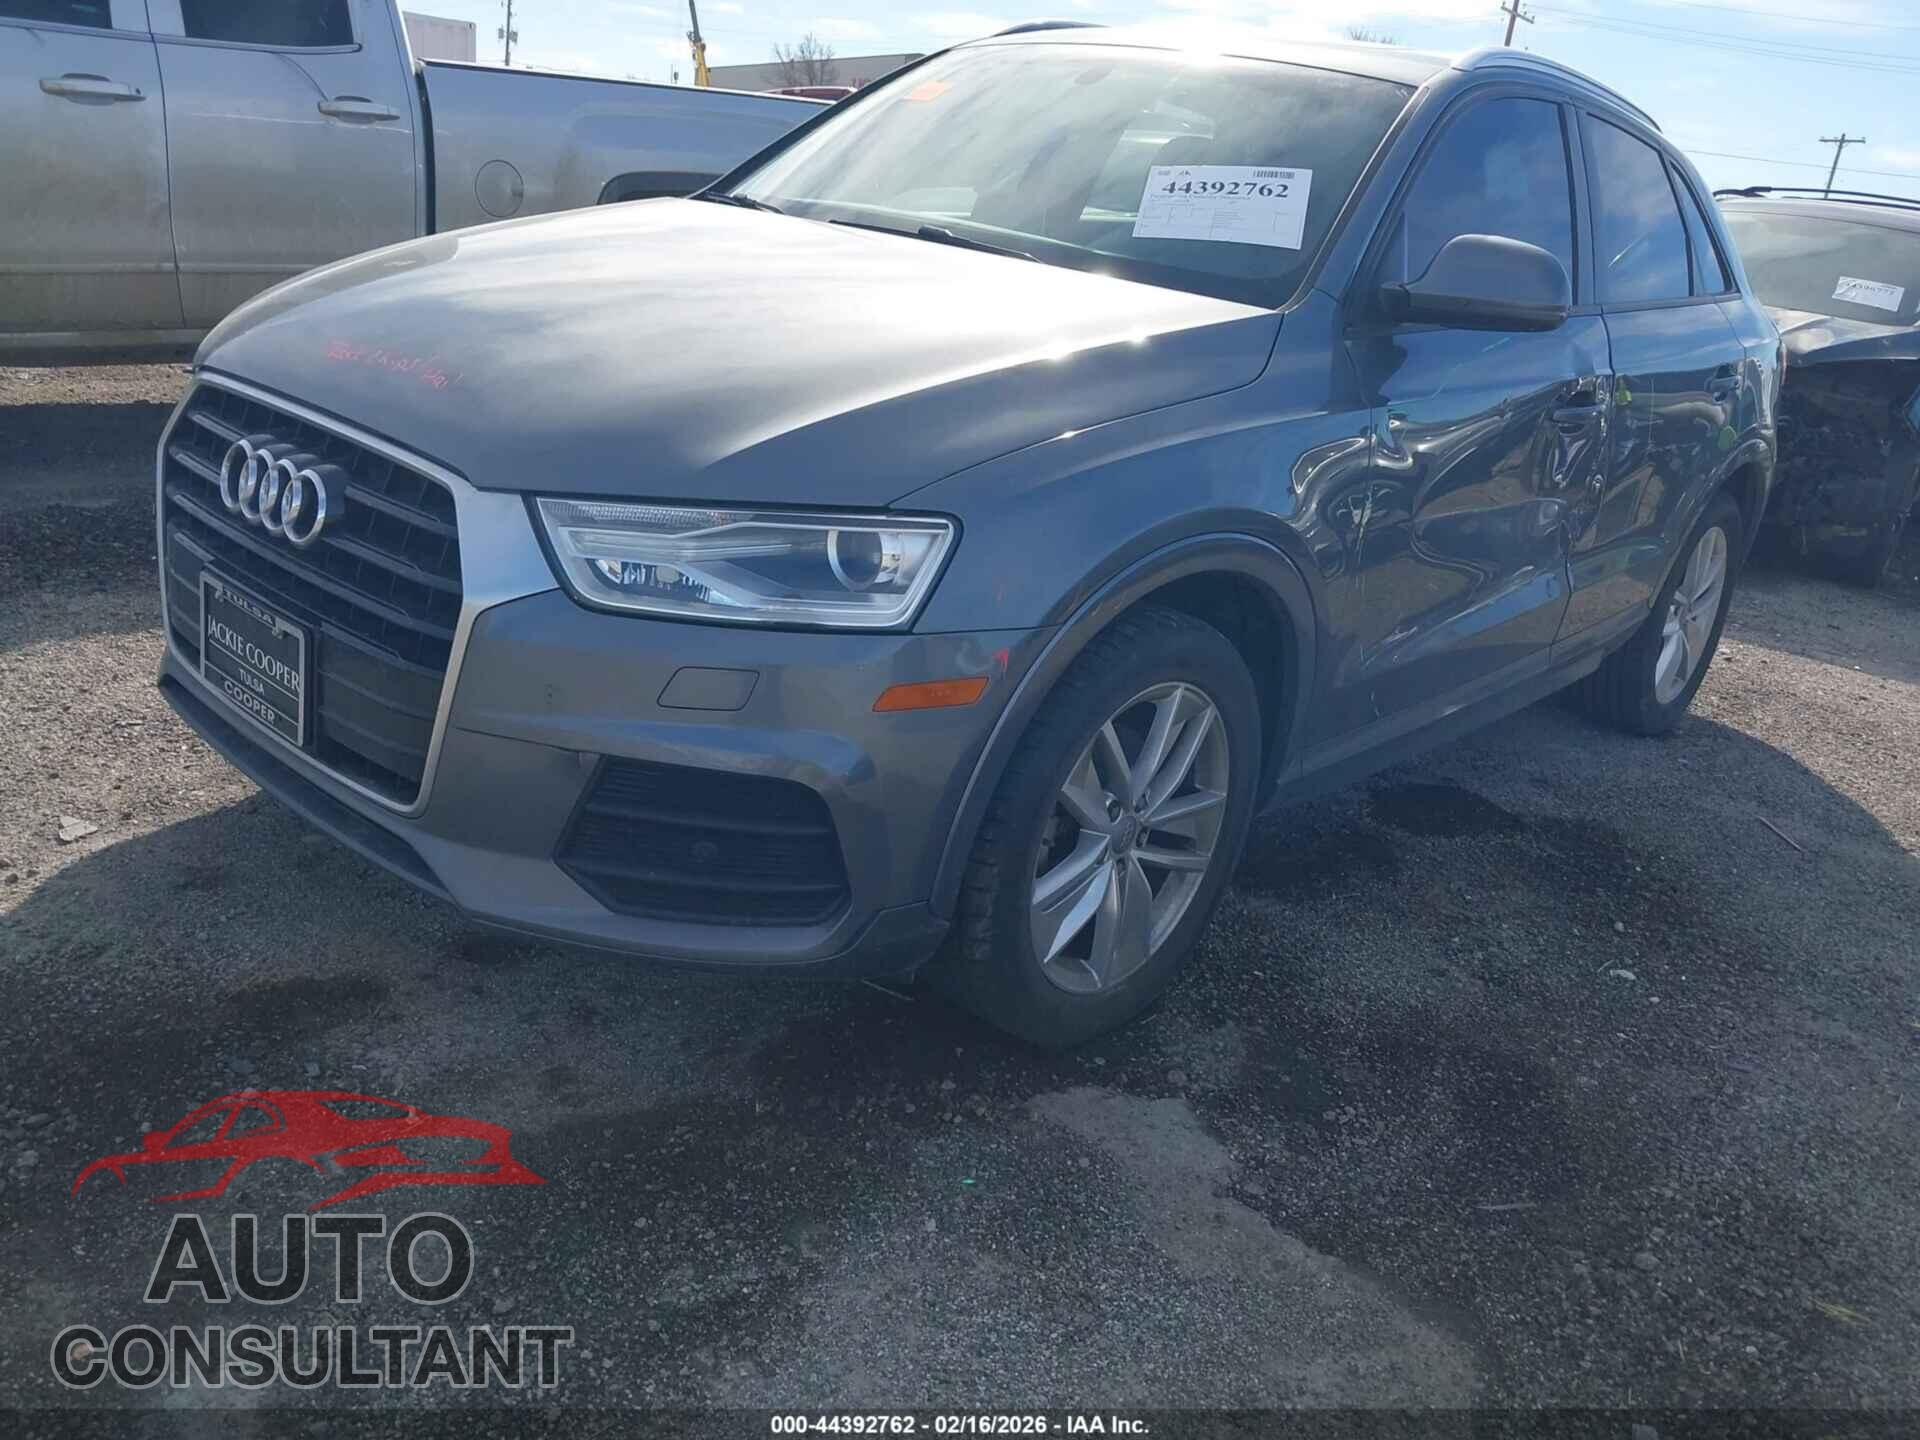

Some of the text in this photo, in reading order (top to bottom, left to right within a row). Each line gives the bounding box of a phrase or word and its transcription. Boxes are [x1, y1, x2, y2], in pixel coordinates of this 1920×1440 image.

[1162, 180, 1289, 199] 44392762
[207, 615, 300, 691] JACKIE COOPER
[239, 668, 266, 696] TULSA
[224, 680, 275, 725] COOPER
